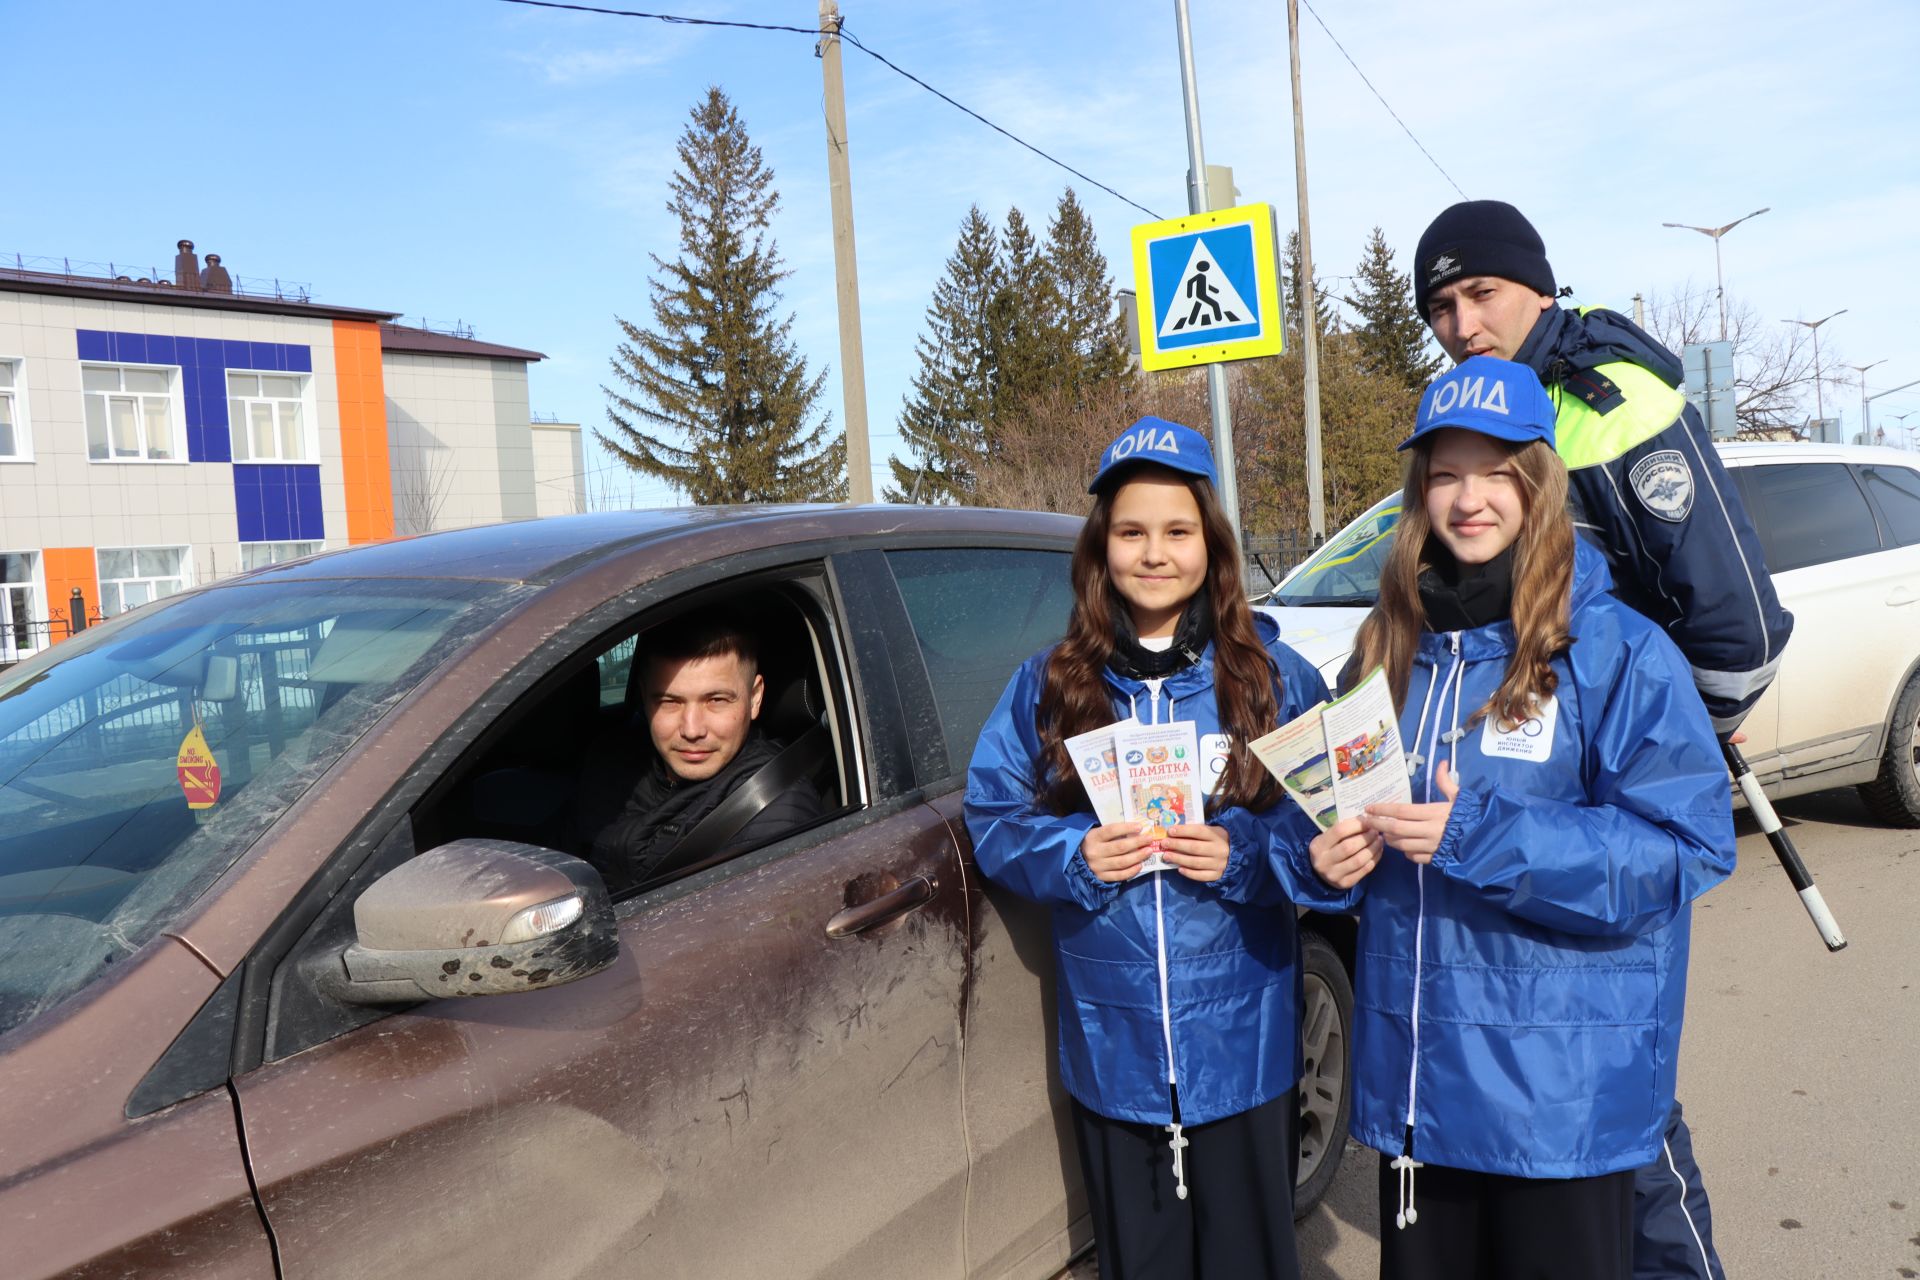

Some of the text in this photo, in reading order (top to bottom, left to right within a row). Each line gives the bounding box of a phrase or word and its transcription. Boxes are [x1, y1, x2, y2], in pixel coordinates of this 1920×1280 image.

[1427, 376, 1509, 421] ЮИД
[1111, 428, 1180, 463] ЮИД
[1634, 454, 1681, 481] ПОЛИЦИЯ
[1641, 465, 1682, 490] РОССИЯ
[187, 747, 196, 755] NO
[1497, 741, 1534, 749] ИНСПЕКТОР
[1497, 746, 1533, 755] ДВИЖЕНИЯ
[180, 755, 204, 764] SMOKING
[1091, 770, 1118, 786] ПАМ
[1128, 762, 1191, 778] ПАМЯТКА
